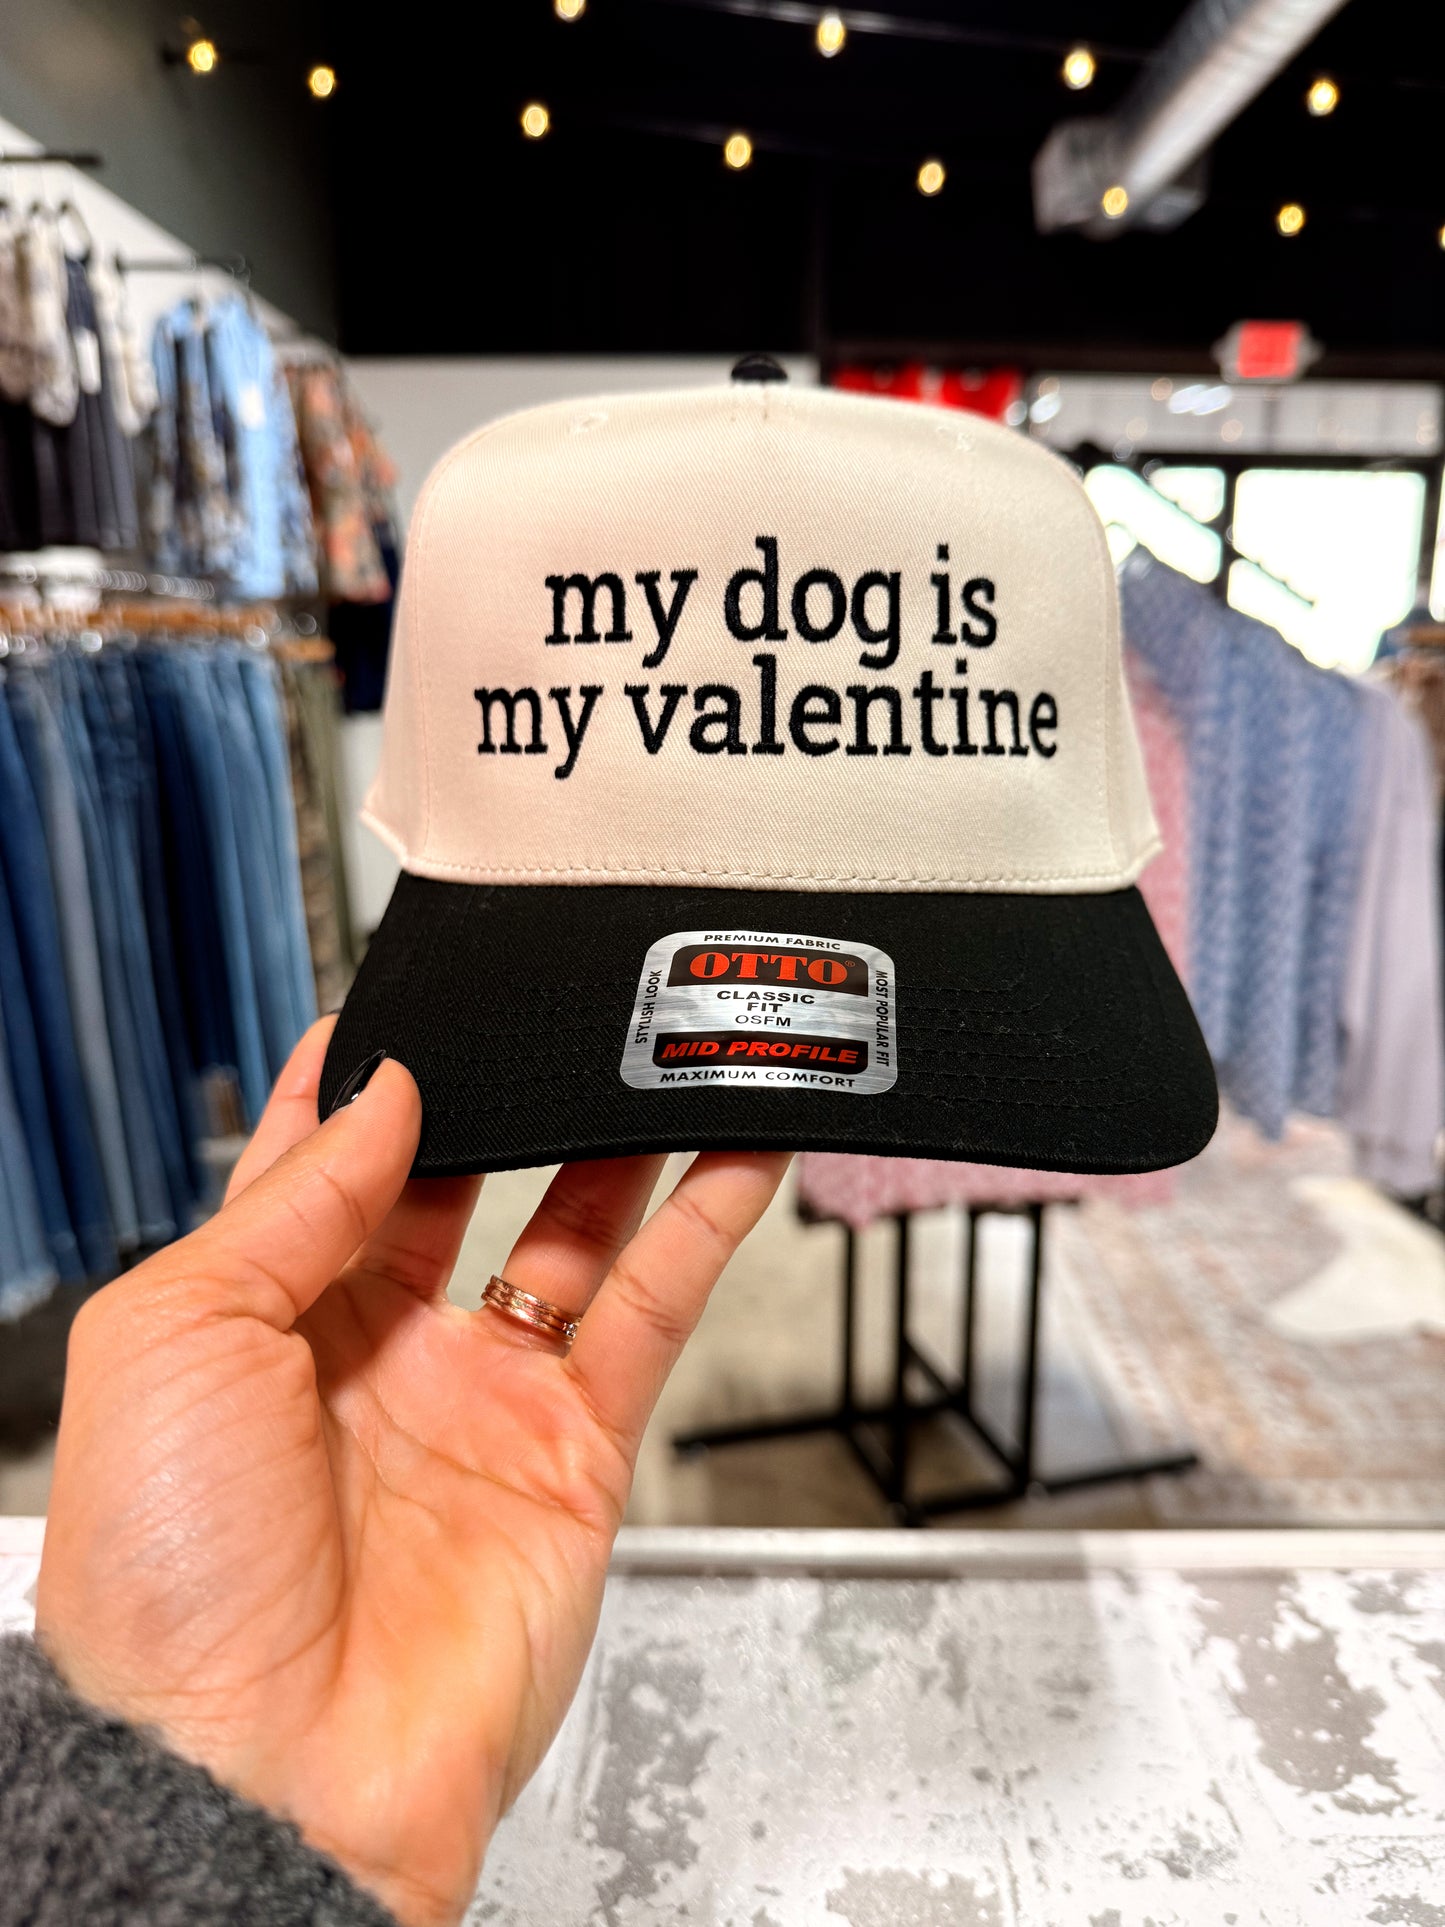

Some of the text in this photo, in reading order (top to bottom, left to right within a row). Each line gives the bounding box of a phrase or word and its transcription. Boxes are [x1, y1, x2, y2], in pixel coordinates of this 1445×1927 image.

[544, 536, 998, 670] my dog is
[473, 653, 1059, 779] my valentine
[704, 934, 841, 950] PREMIUM FABRIC
[635, 969, 662, 1044] STYLISH LOOK
[716, 990, 815, 1005] CLASSIC
[746, 1002, 783, 1013] FIT
[735, 1015, 791, 1027] OSFM
[875, 970, 889, 1066] MOST POPULAR FIT
[661, 1041, 859, 1064] MID PROFILE
[660, 1070, 856, 1088] MAXIMUM COMFORT
